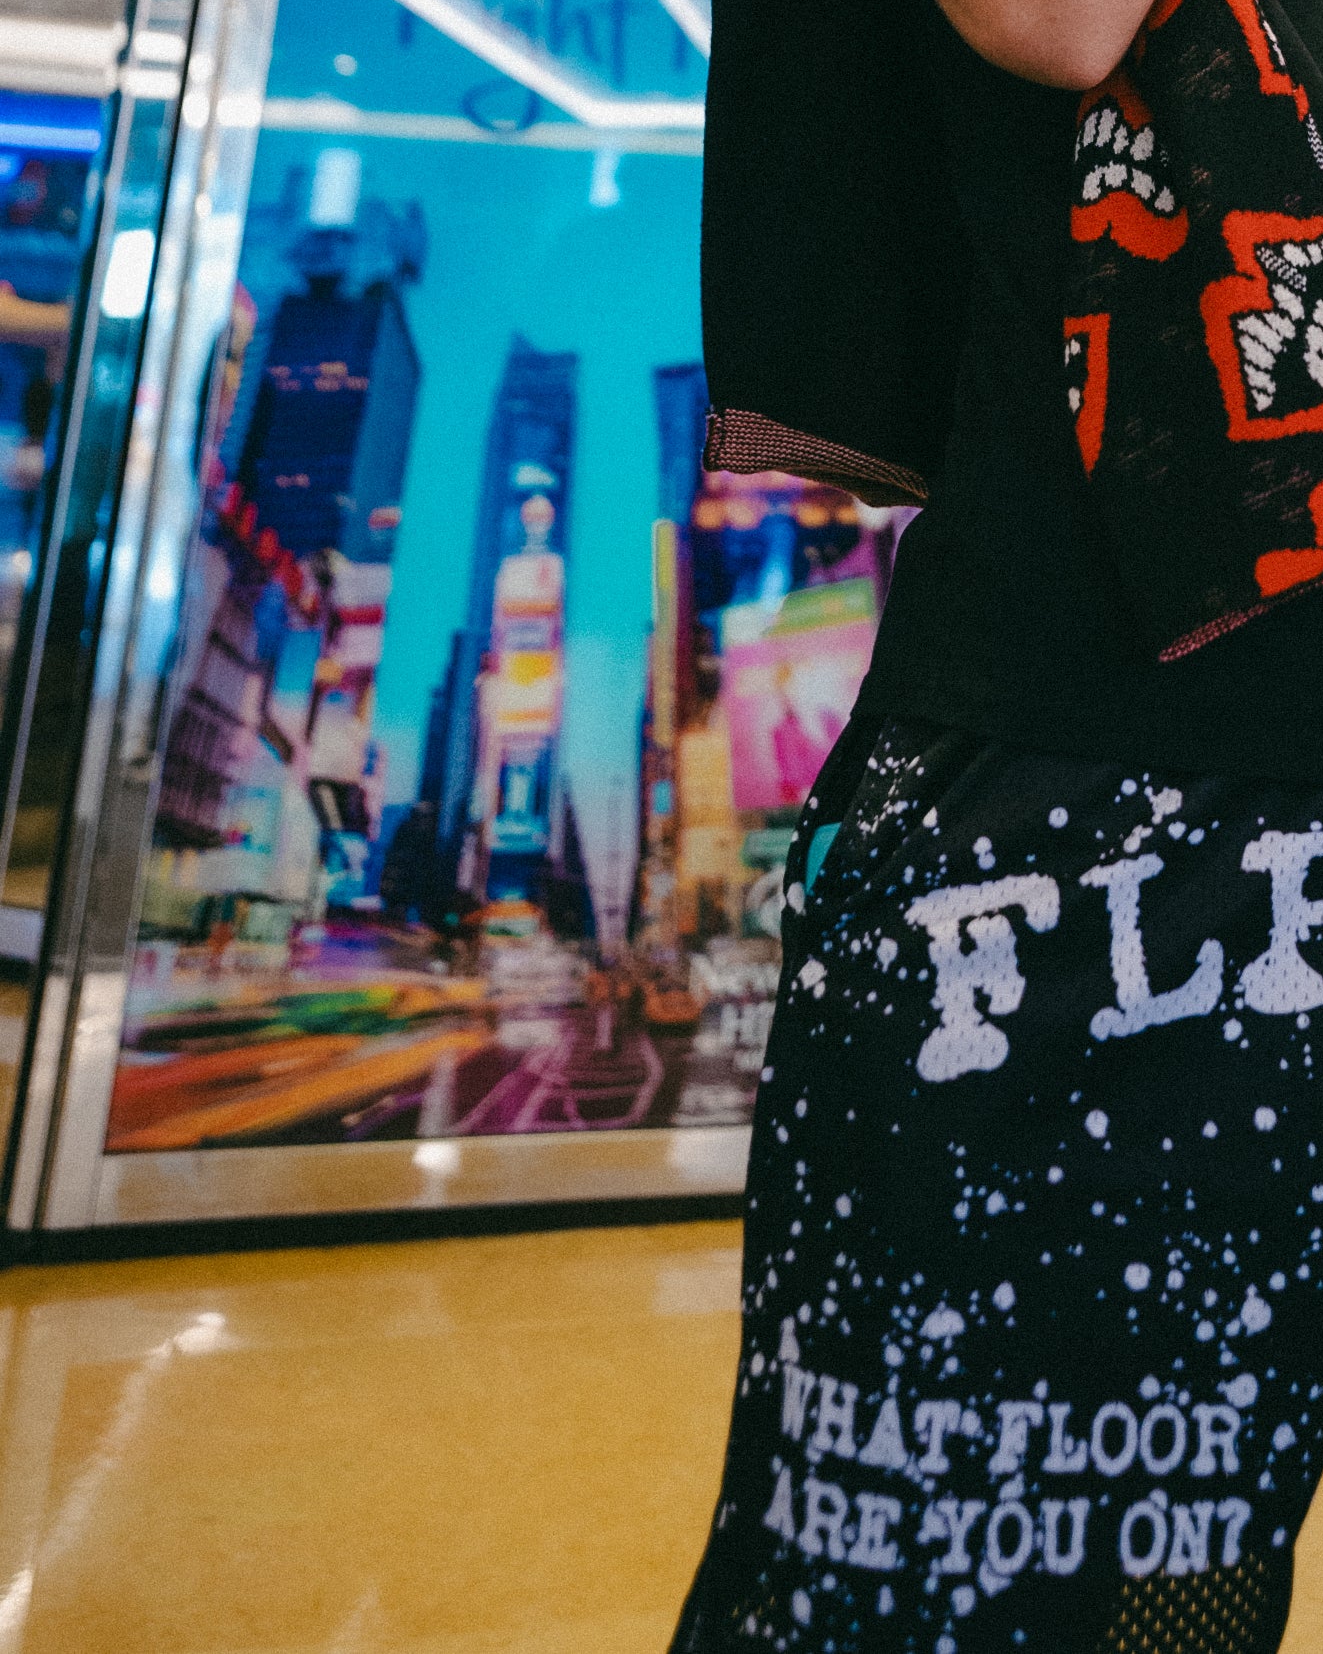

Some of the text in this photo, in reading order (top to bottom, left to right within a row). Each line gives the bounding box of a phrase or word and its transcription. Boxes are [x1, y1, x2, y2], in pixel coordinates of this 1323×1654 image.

[781, 1364, 1242, 1477] WHAT FLOOR
[764, 1465, 1252, 1577] ARE YOU ON?
